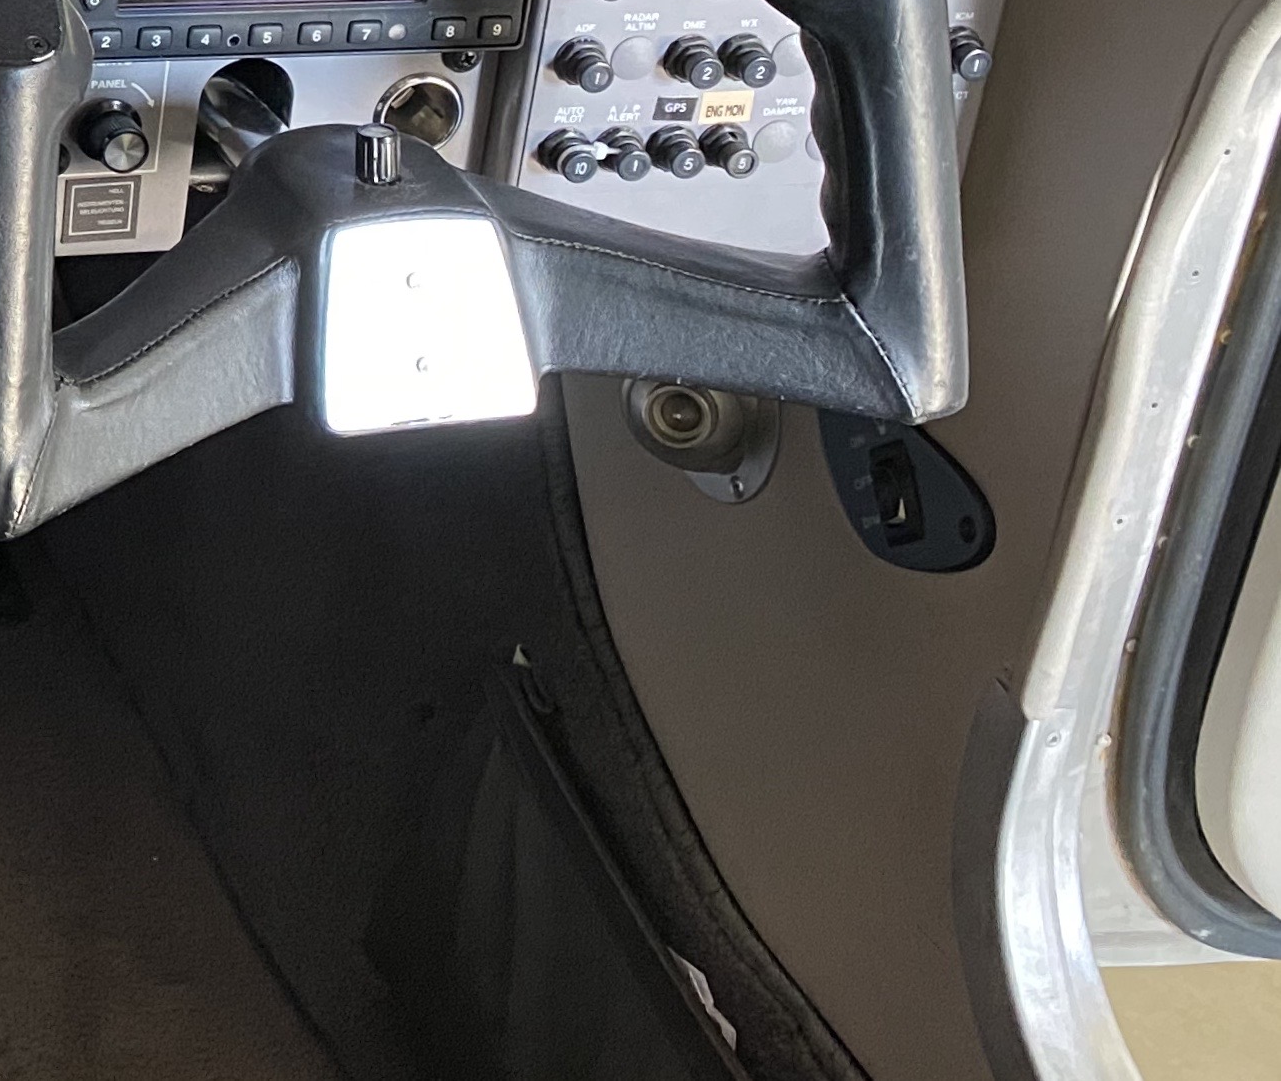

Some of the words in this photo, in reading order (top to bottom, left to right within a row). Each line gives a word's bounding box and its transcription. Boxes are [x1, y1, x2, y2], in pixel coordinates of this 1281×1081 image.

[664, 102, 687, 113] GPS
[705, 104, 724, 119] ENG
[725, 104, 746, 117] MON
